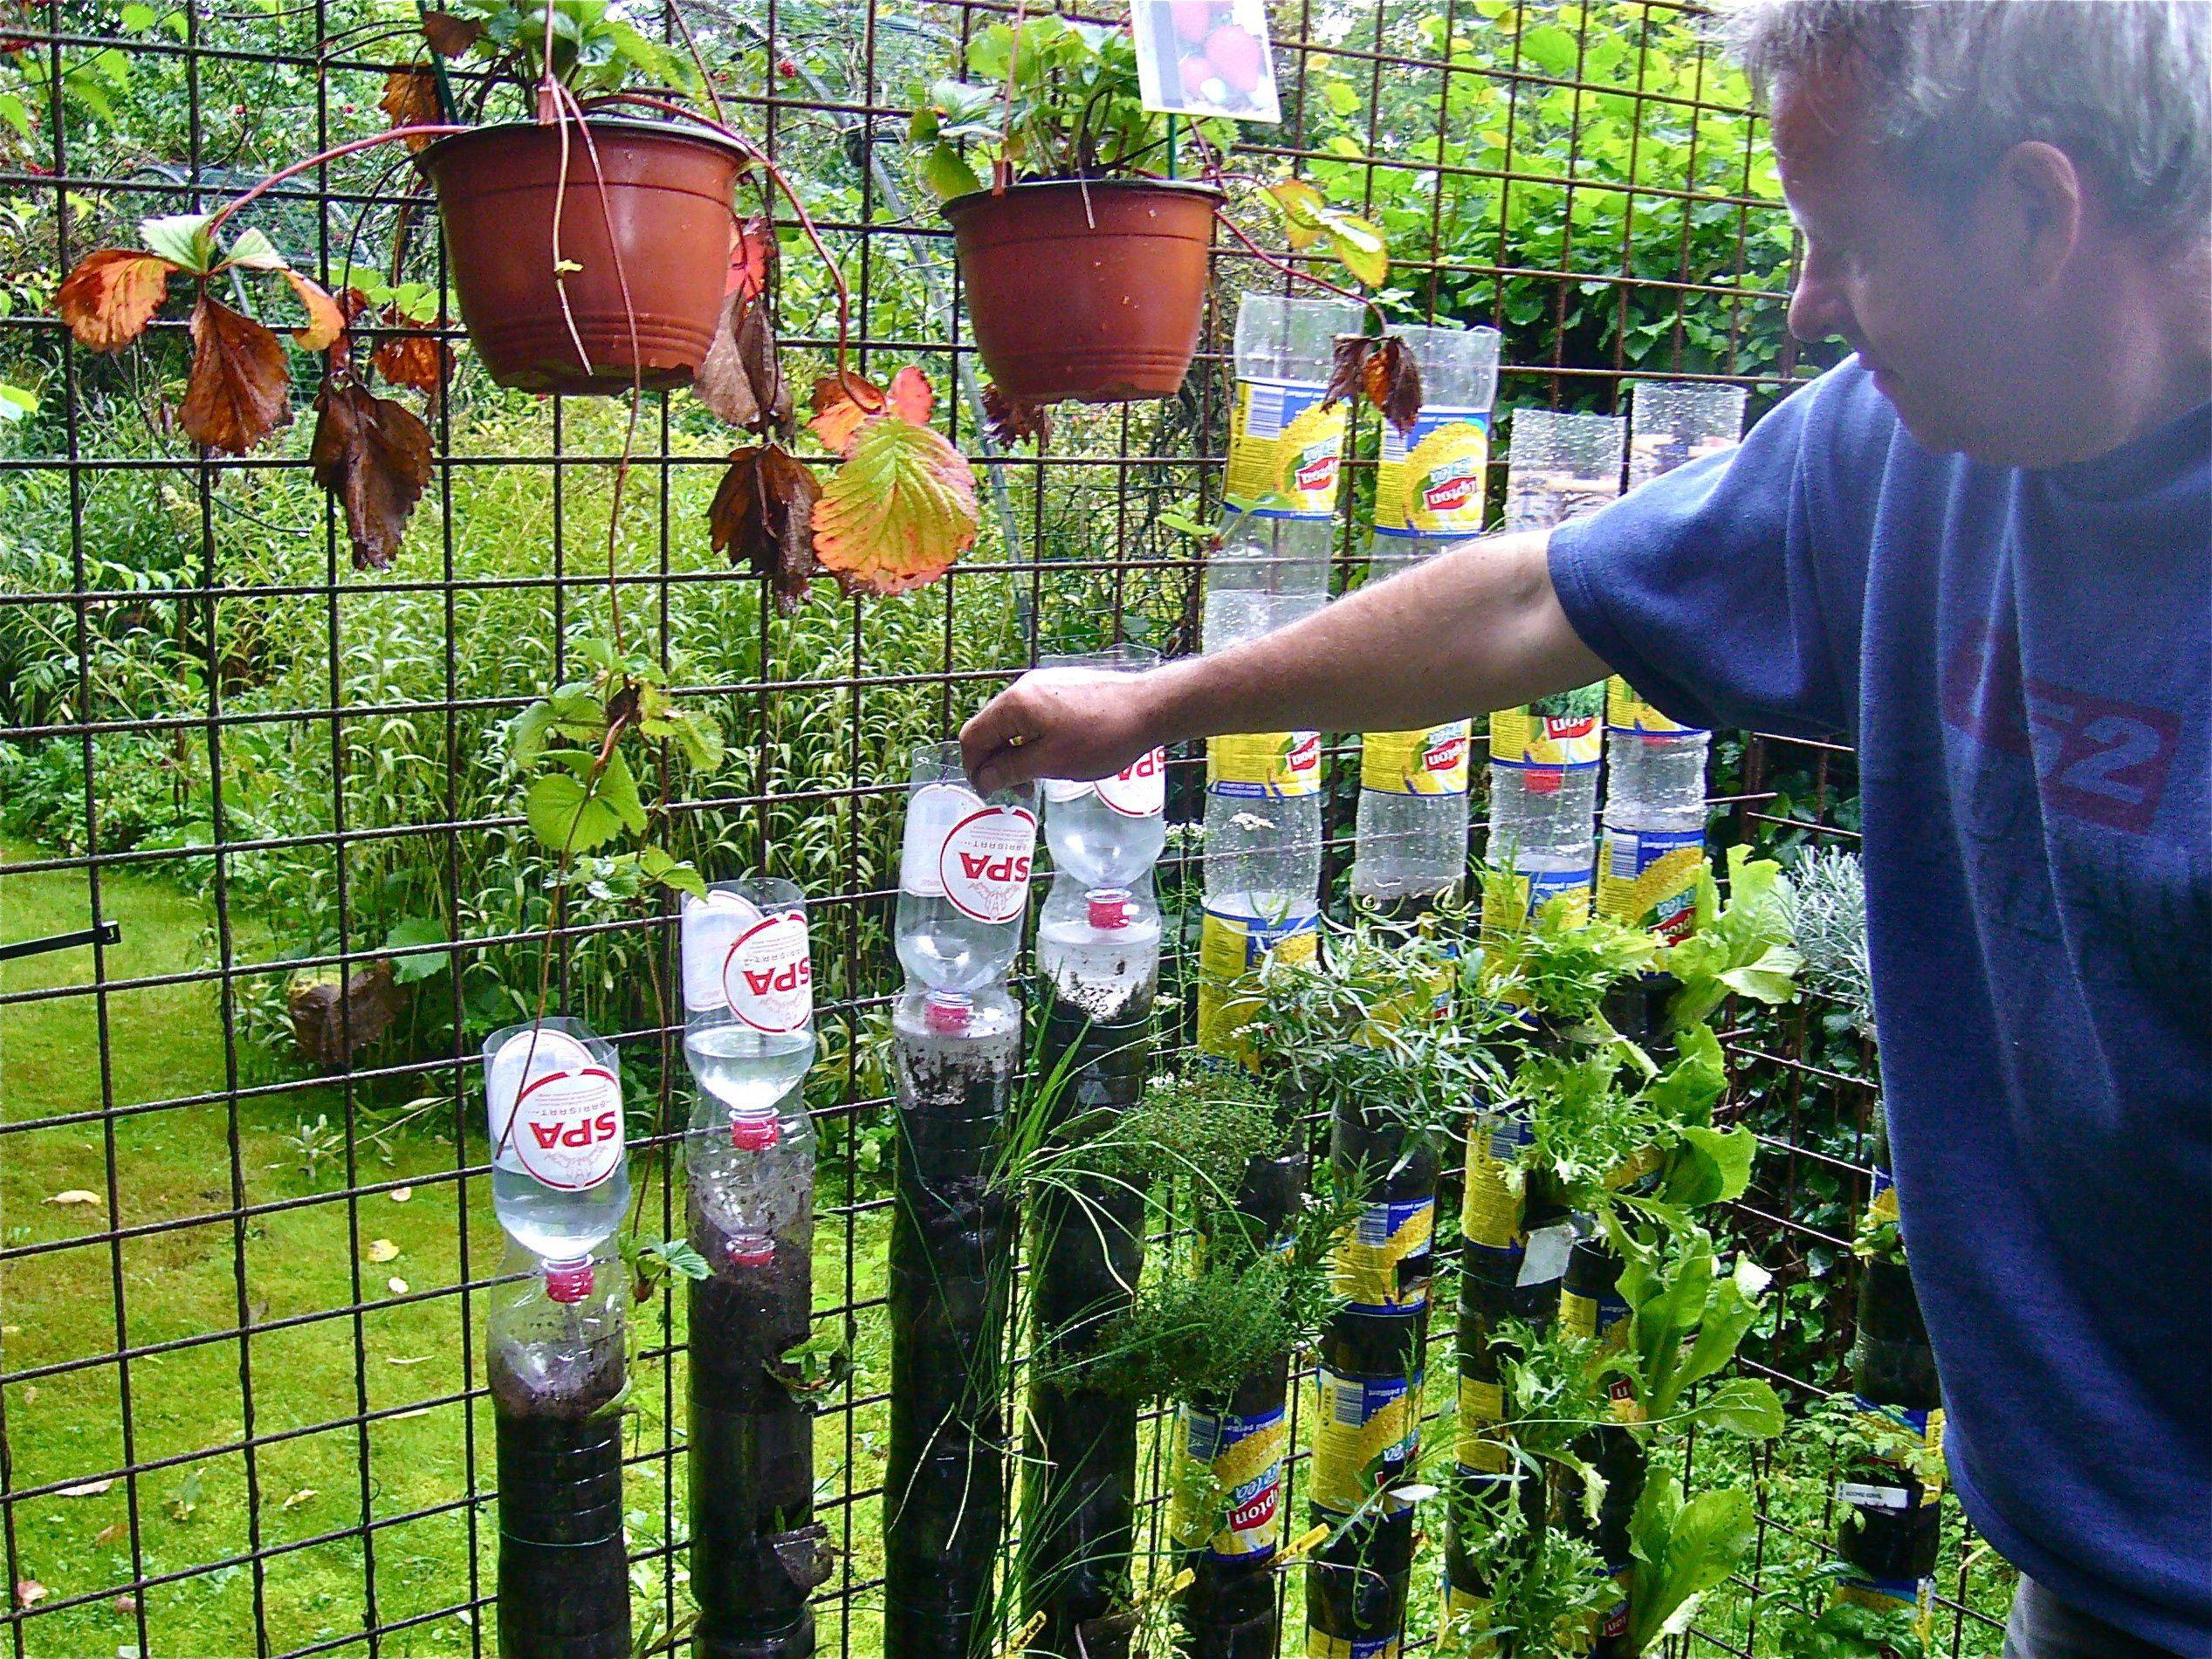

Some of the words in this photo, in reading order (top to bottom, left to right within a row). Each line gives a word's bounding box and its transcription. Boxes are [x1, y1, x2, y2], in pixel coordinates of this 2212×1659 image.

[958, 851, 1031, 882] SPA
[741, 956, 811, 997] SPA
[527, 1109, 618, 1150] SPA
